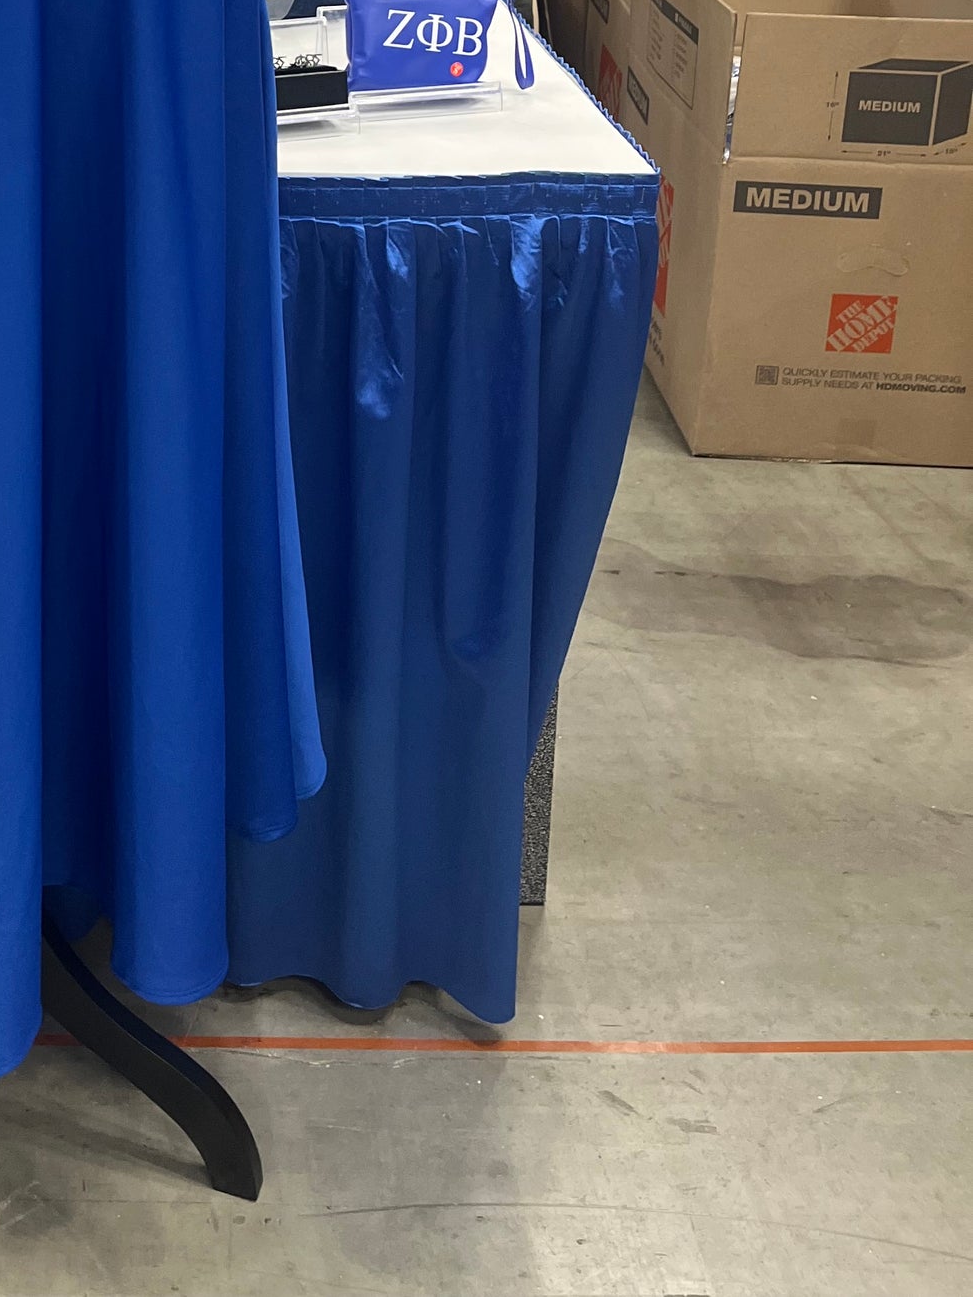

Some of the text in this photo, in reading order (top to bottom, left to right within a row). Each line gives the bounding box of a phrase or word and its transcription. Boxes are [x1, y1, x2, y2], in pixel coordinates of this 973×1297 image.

[382, 8, 483, 56] ΖΦΒ
[858, 99, 921, 114] MEDIUM
[746, 186, 870, 213] MEDIUM
[827, 296, 897, 352] HOME
[852, 318, 894, 352] DEPOT
[781, 376, 966, 395] SUPPLY NEEDS AT HDMOVING.COM
[783, 366, 962, 384] QUICKLY ESTIMATE YOUR PACKING
